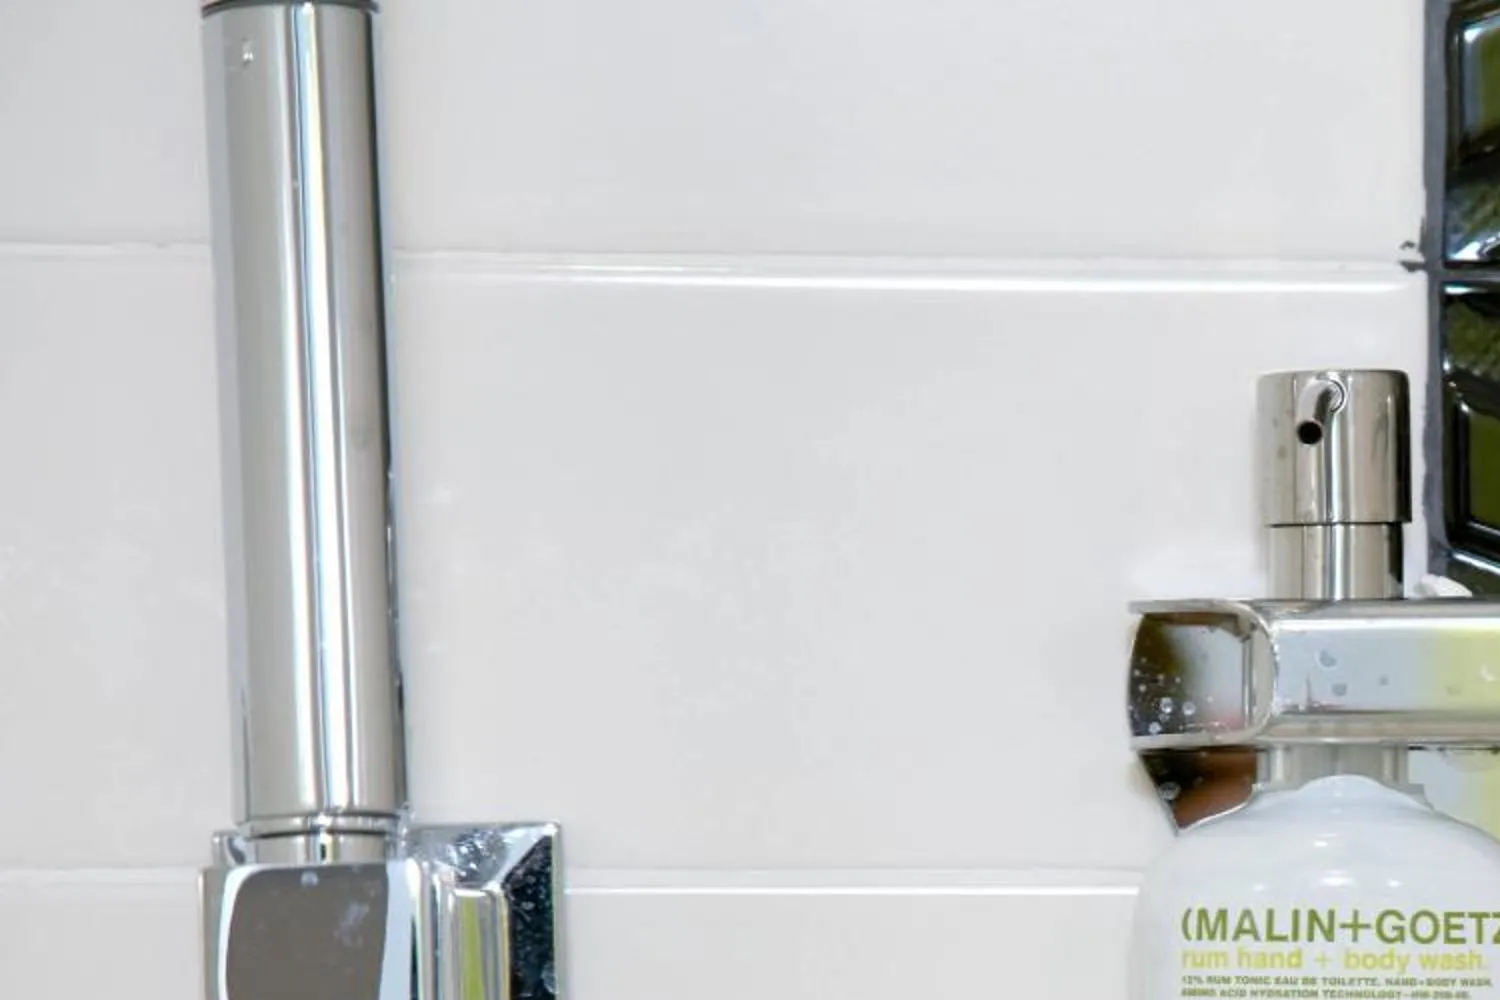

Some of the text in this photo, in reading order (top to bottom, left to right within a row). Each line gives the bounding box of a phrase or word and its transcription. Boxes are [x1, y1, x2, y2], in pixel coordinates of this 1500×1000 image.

[1181, 950, 1228, 970] rum
[1238, 946, 1303, 970] hand
[1343, 948, 1411, 974] body
